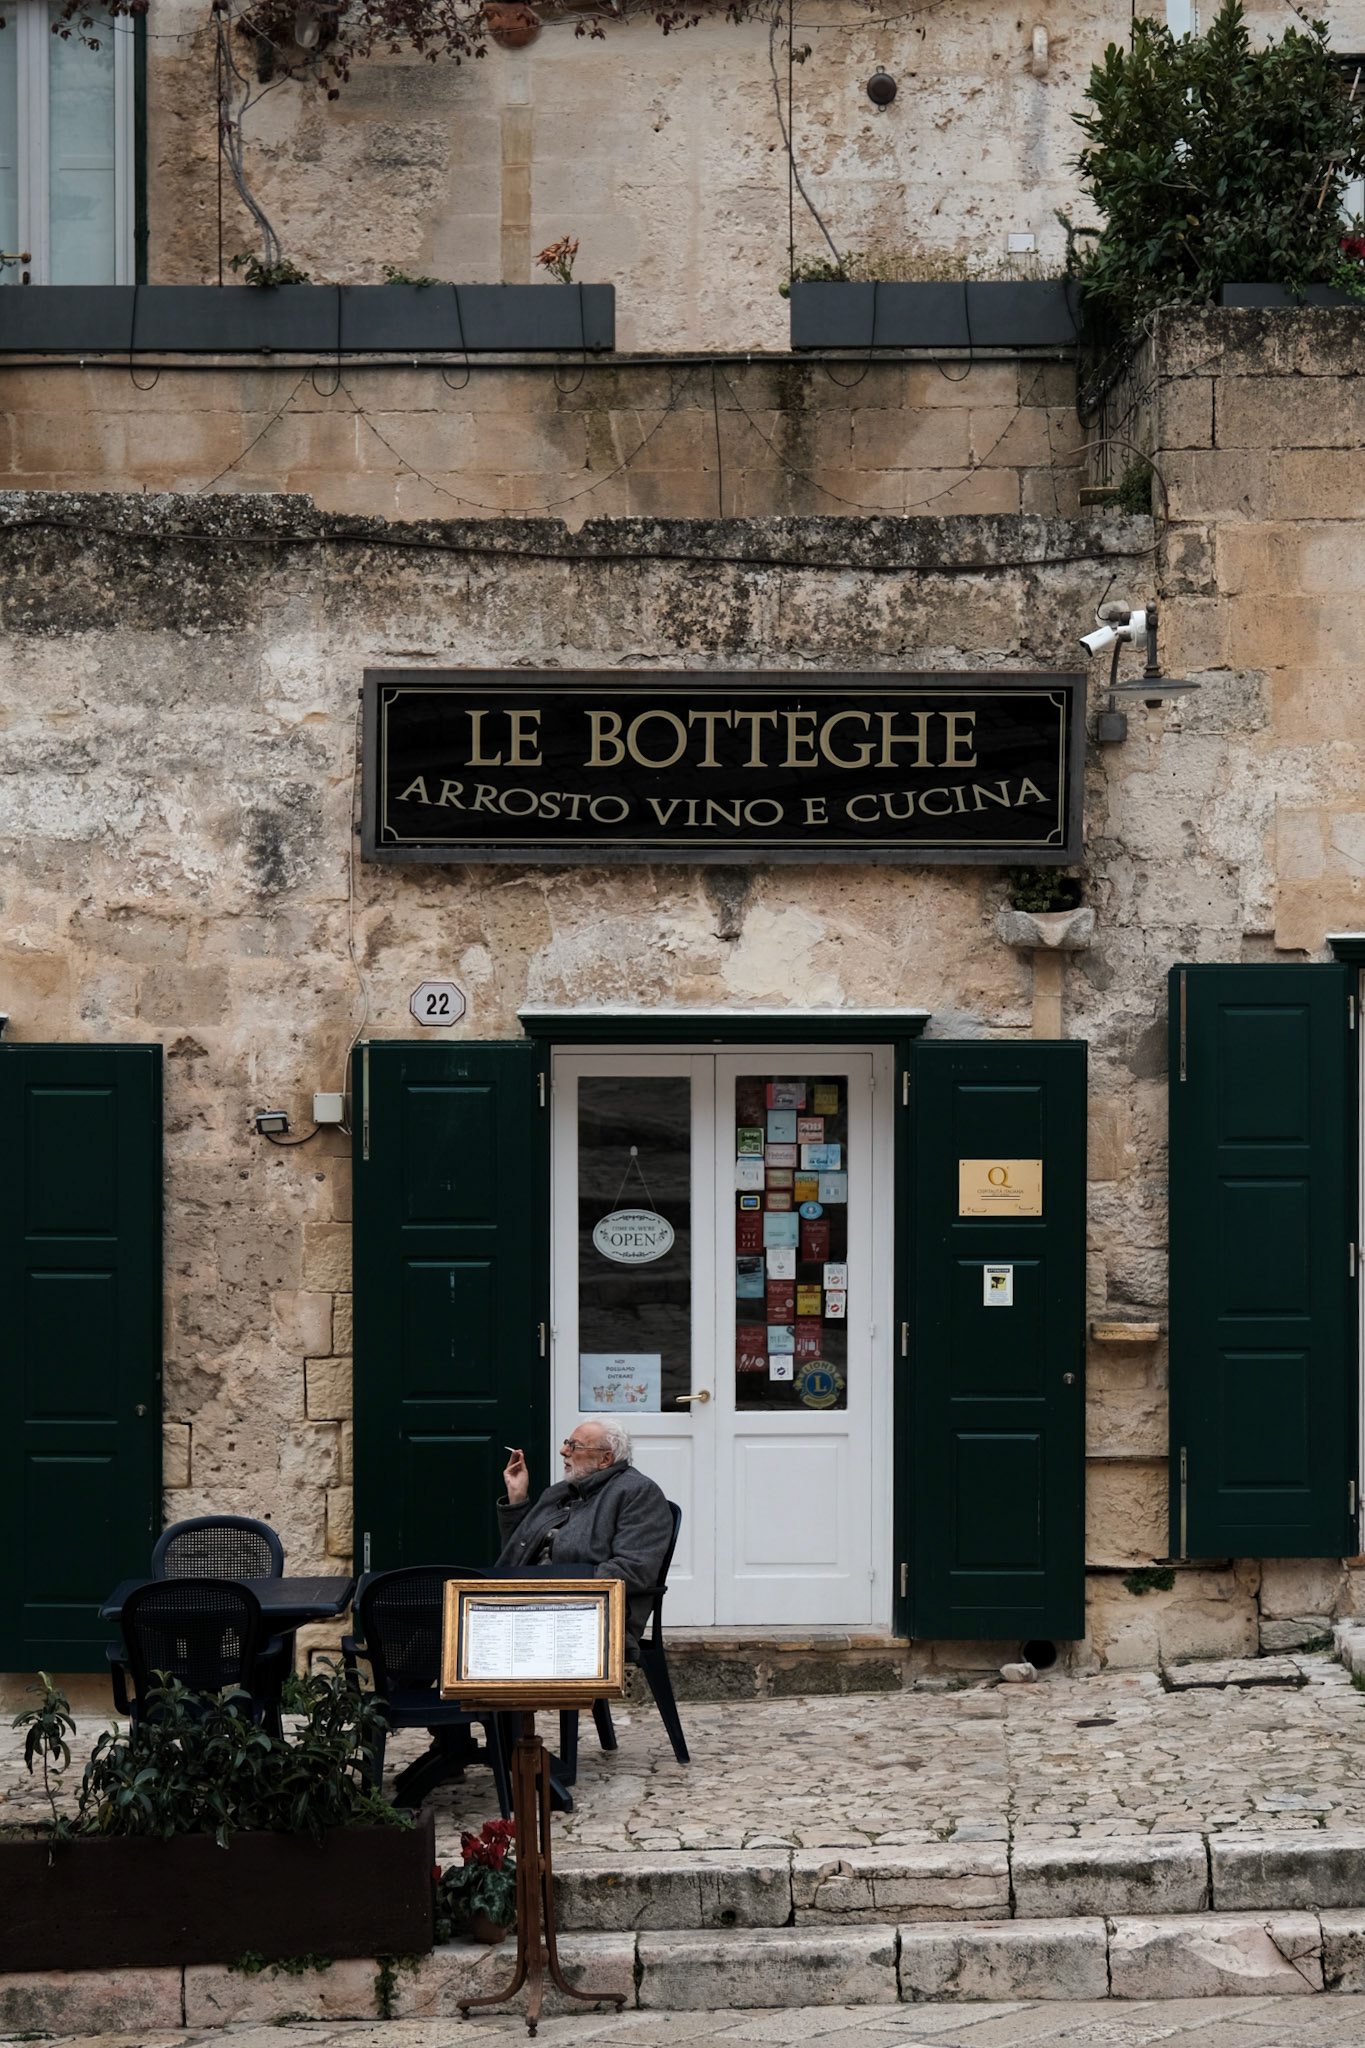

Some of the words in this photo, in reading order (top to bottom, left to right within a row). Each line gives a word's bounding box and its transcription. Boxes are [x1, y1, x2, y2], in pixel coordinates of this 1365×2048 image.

[464, 709, 543, 767] LE
[584, 708, 978, 769] BOTTEGHE
[396, 774, 630, 824] ARROSTO
[646, 797, 785, 827] VINO
[803, 797, 829, 825] E
[845, 776, 1052, 823] CUCINA
[426, 992, 450, 1015] 22
[988, 1166, 1013, 1188] Q
[610, 1232, 656, 1247] OPEN
[804, 1362, 836, 1373] LIONS
[814, 1375, 827, 1392] L
